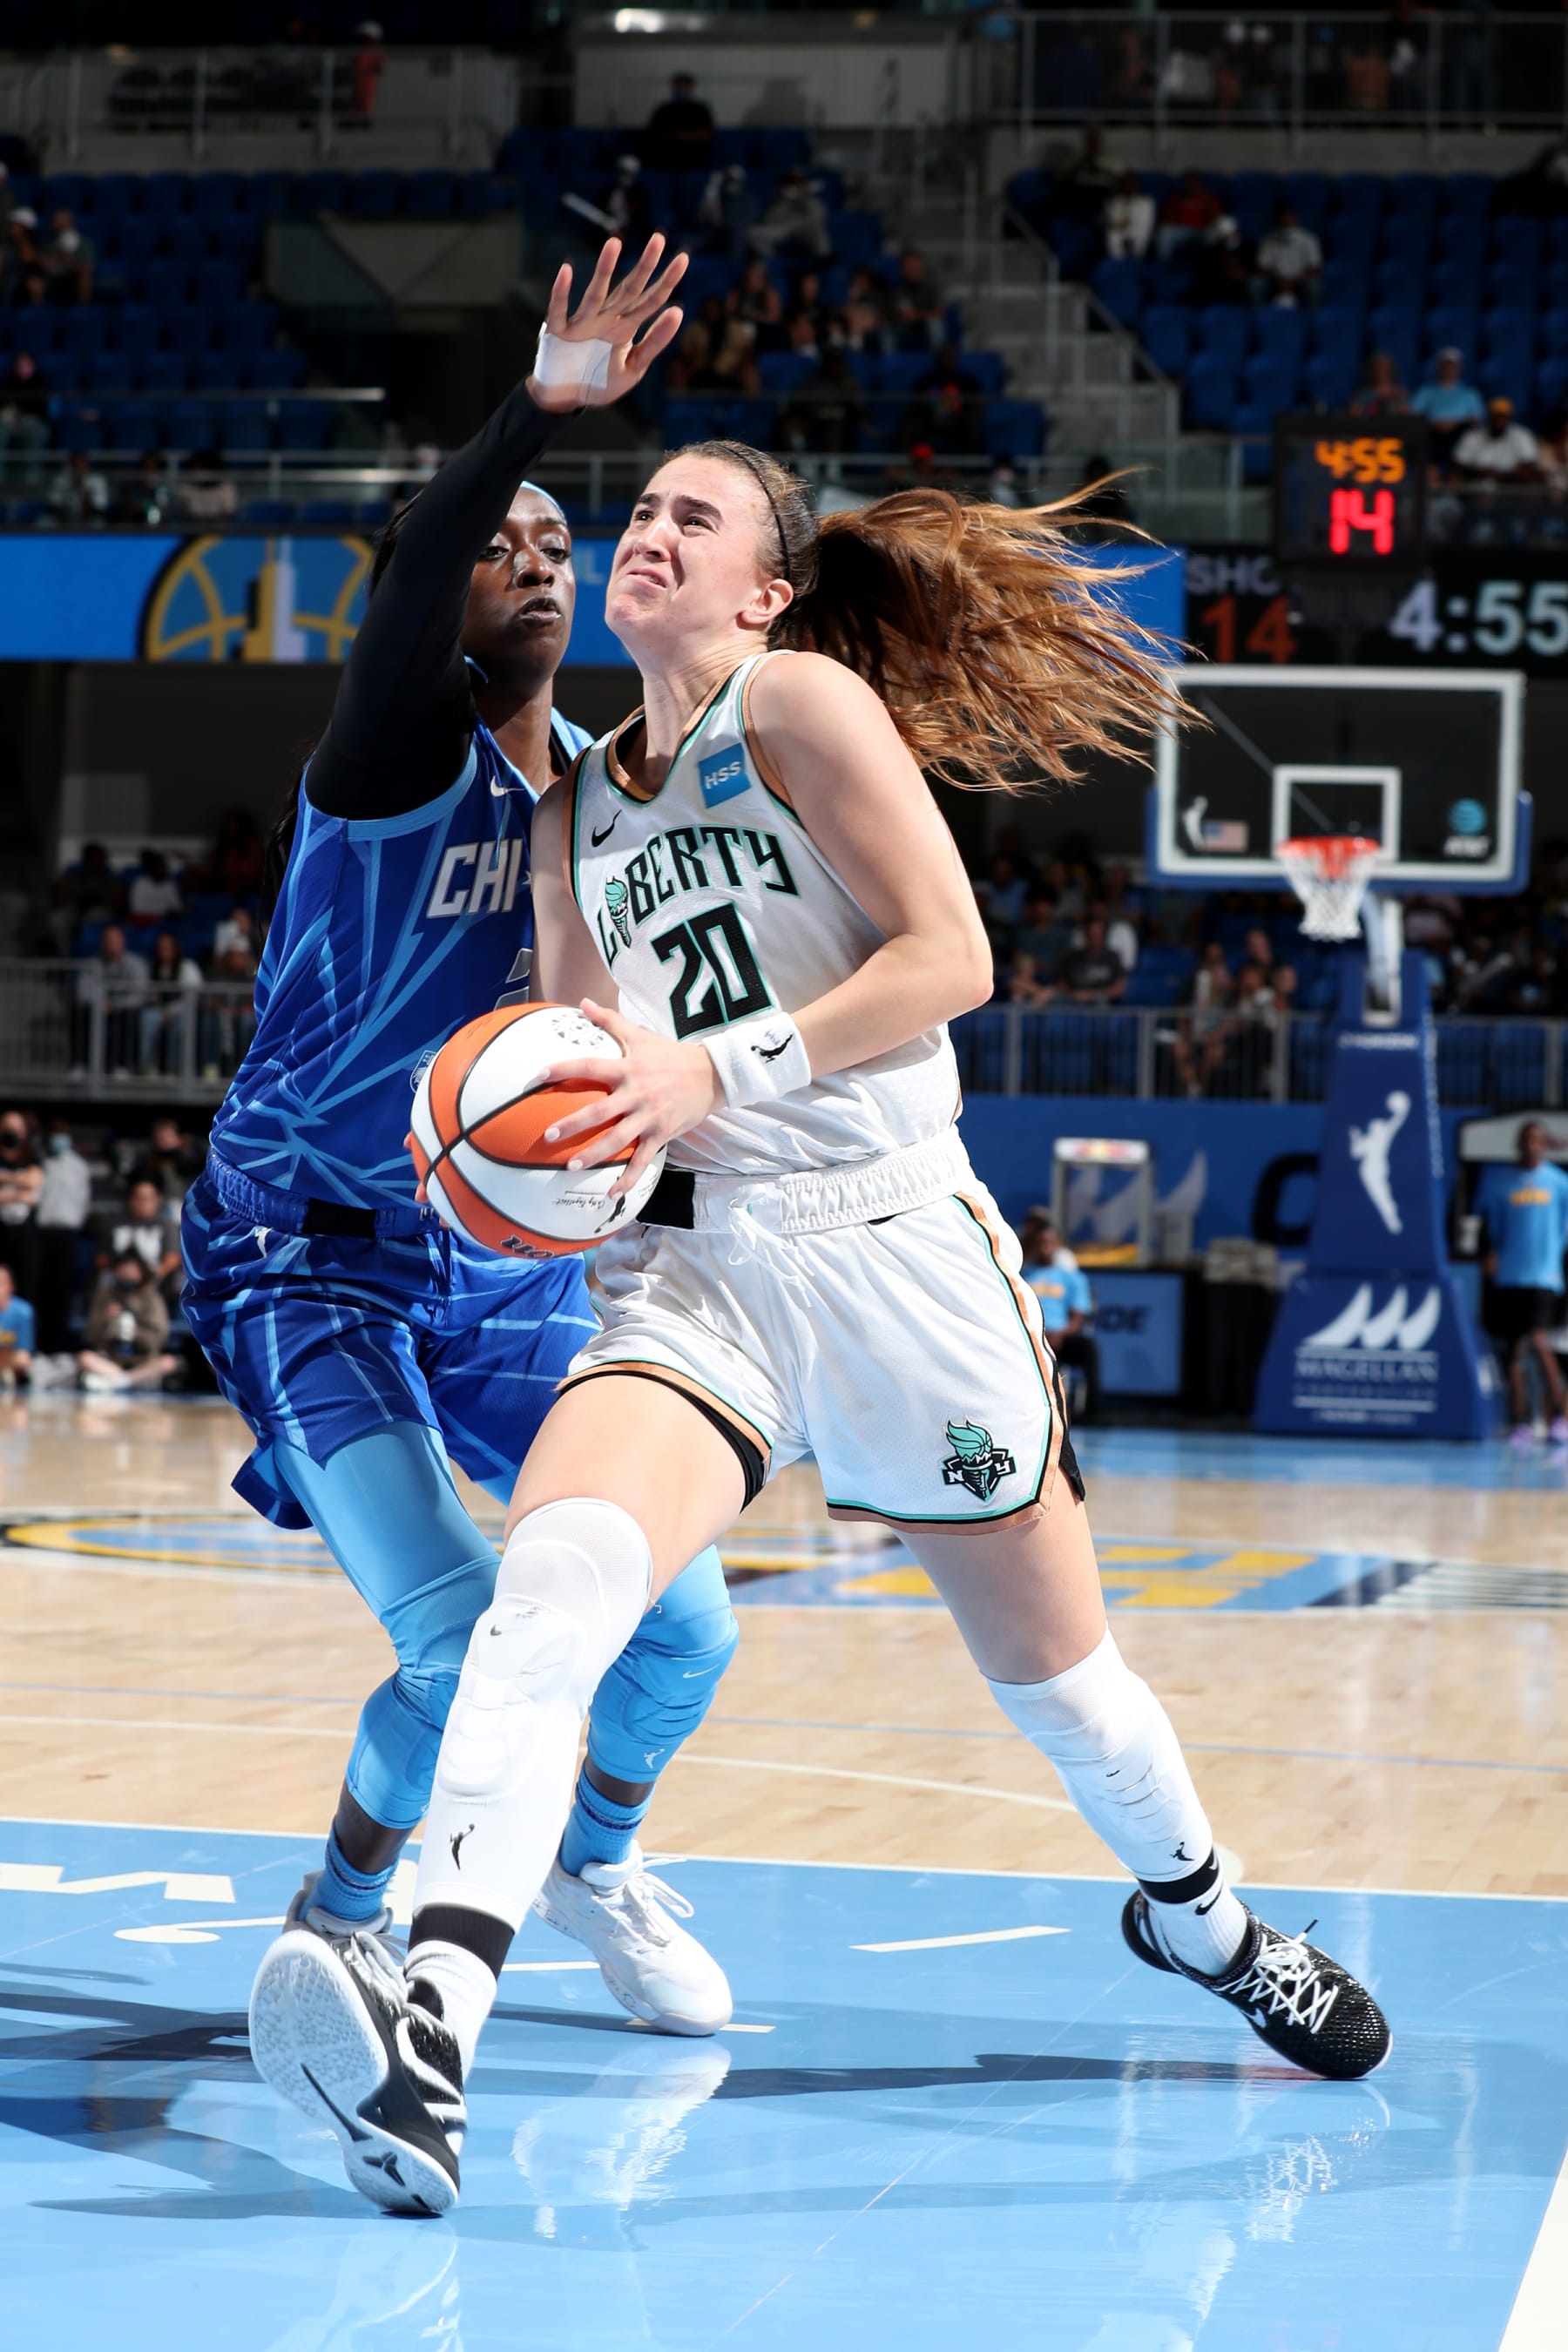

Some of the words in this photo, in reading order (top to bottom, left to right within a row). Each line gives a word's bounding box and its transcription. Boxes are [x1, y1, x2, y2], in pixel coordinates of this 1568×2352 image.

[1315, 438, 1406, 483] 4:55
[1330, 488, 1394, 555] 14
[1202, 597, 1297, 664] 14
[1389, 578, 1568, 656] 4:55
[705, 760, 741, 790] HSS
[426, 838, 523, 918] CHI
[649, 900, 774, 1041] 20
[1295, 1359, 1438, 1383] MAGELLAN
